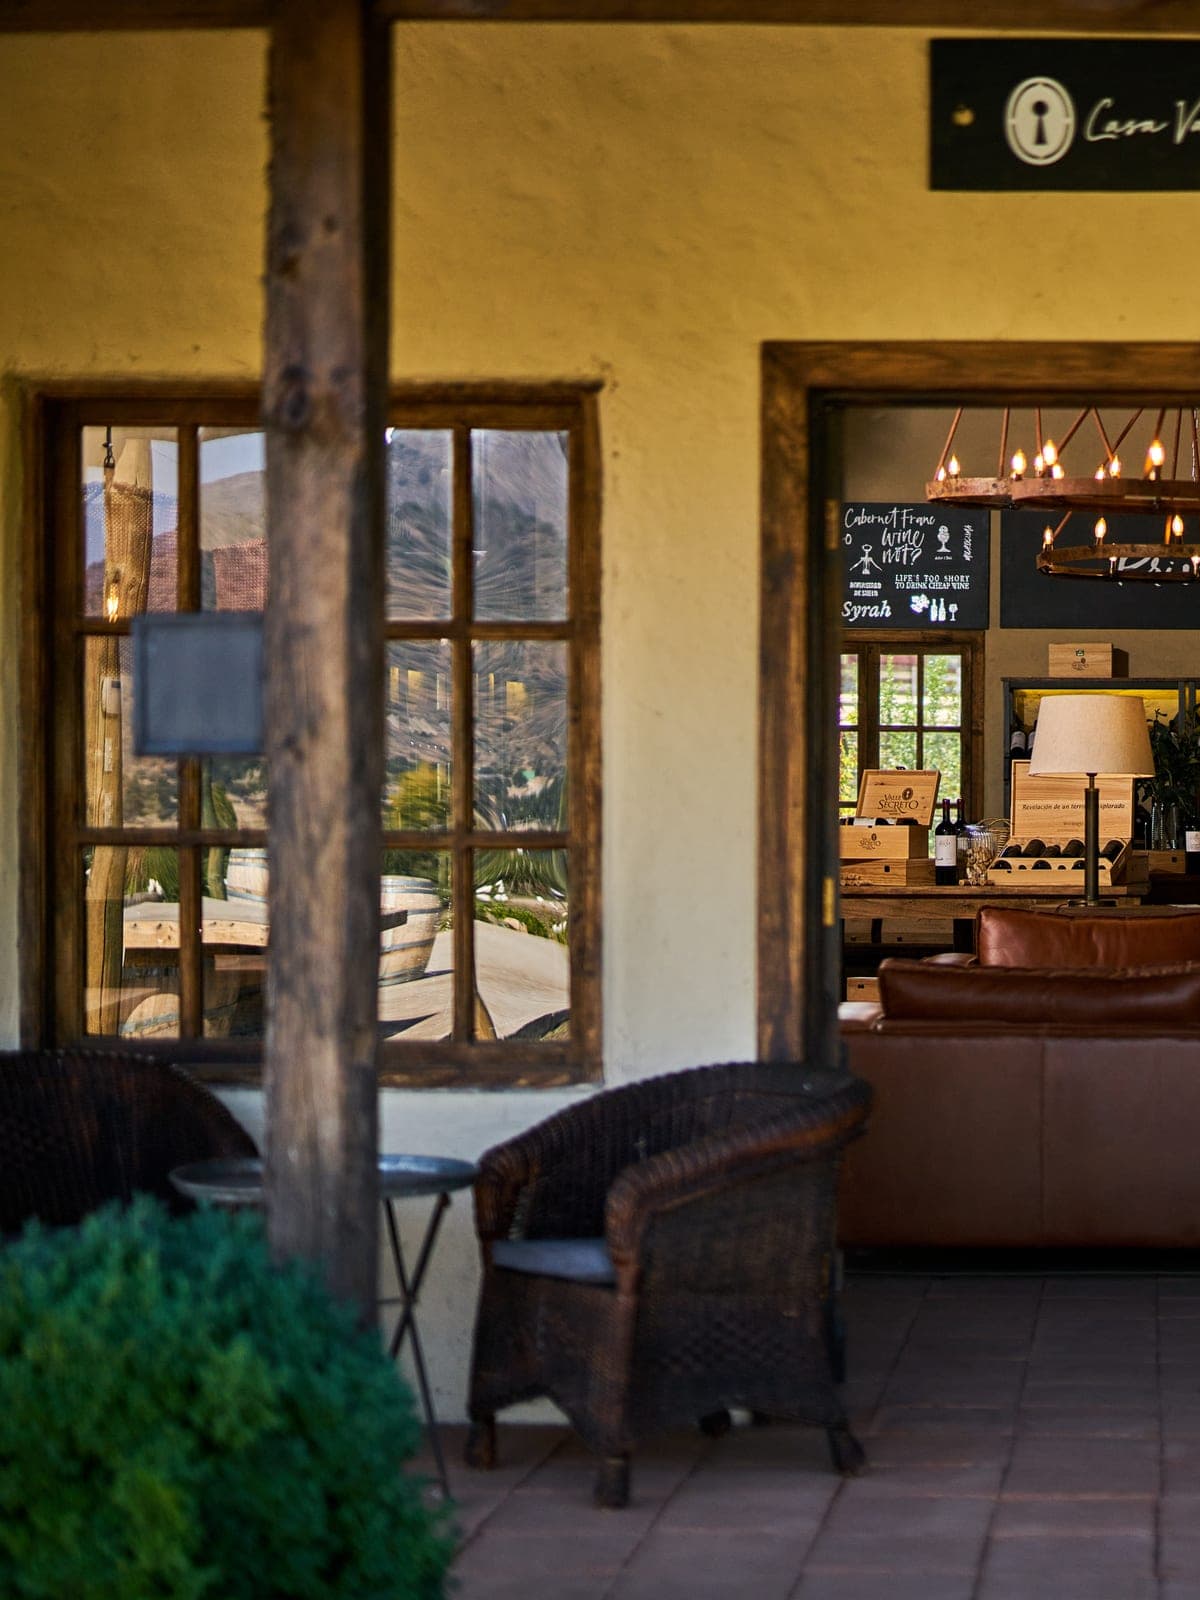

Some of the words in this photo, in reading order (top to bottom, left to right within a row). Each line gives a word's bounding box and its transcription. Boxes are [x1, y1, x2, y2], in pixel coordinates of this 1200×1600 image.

[1084, 98, 1169, 142] Casa
[844, 507, 899, 529] Cabernet
[900, 508, 936, 529] Franc
[923, 574, 940, 583] TOO
[944, 574, 970, 582] SHORT
[841, 600, 892, 622] Syrah
